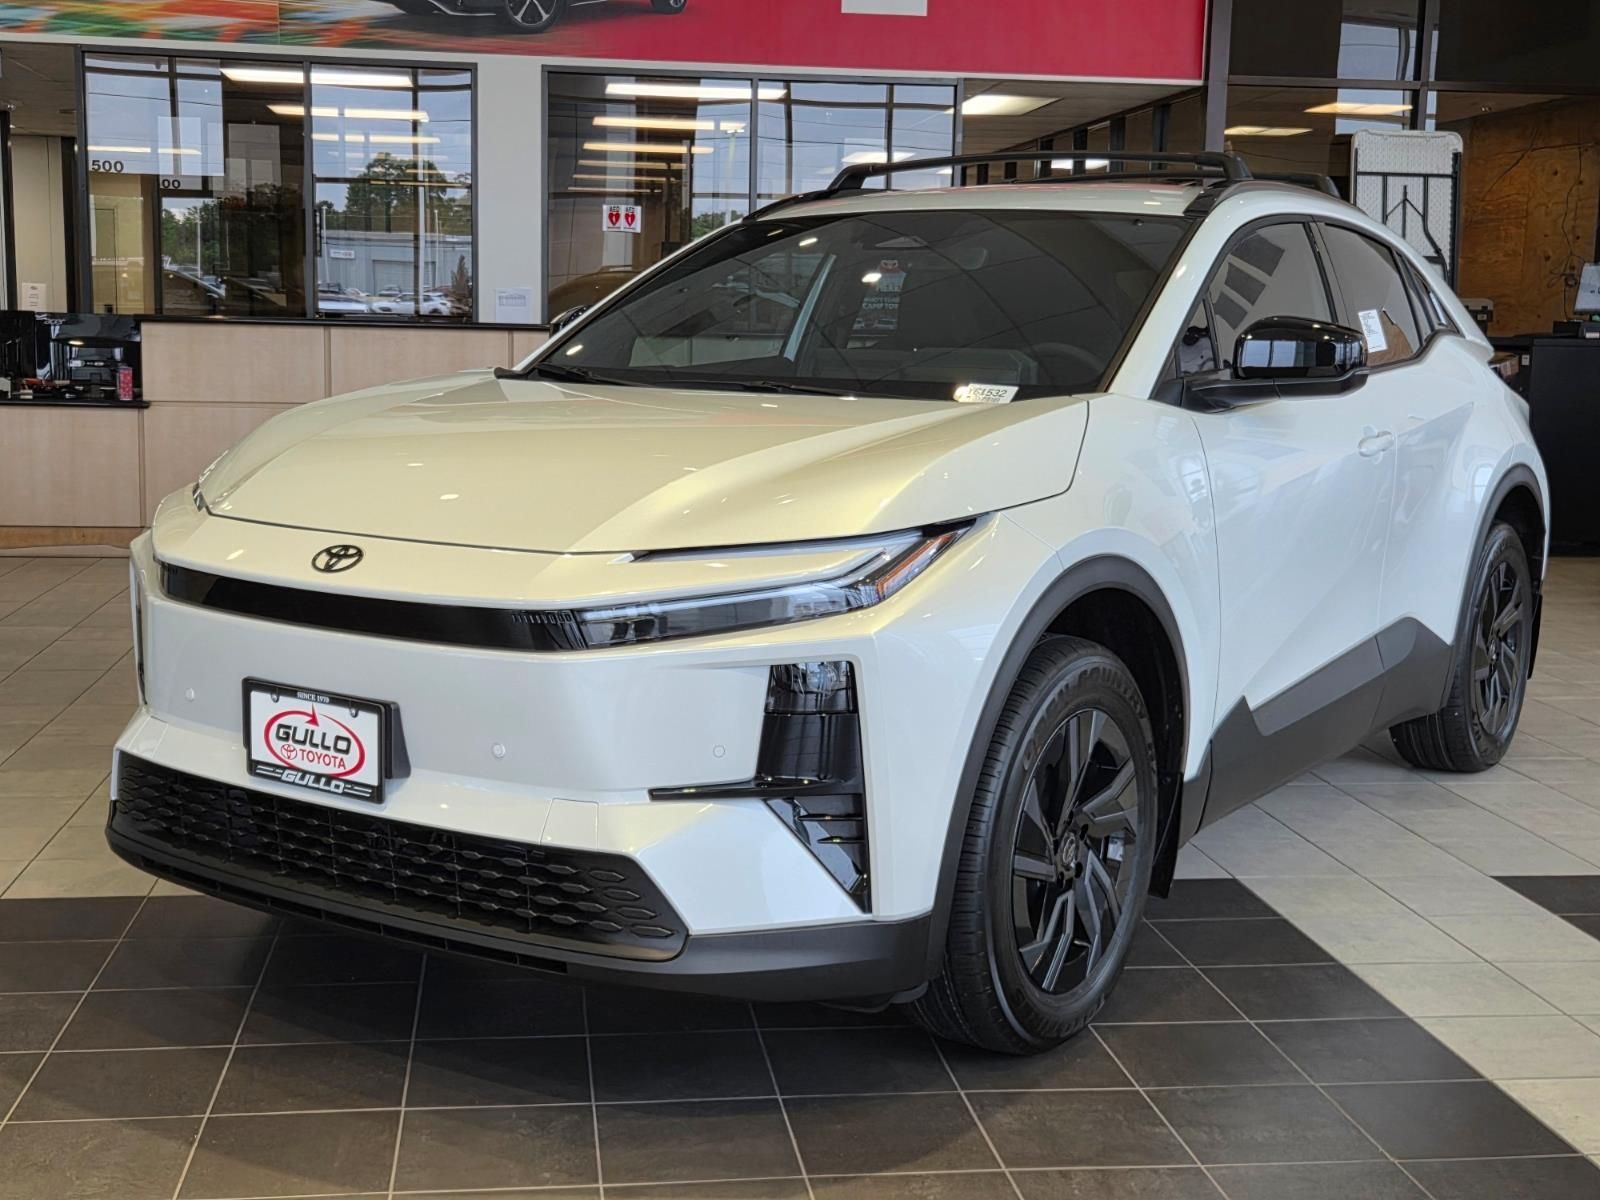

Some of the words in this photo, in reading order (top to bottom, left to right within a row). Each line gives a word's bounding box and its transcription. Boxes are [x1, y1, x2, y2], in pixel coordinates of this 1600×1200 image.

[91, 160, 124, 173] 500
[297, 691, 316, 702] SINCE
[275, 723, 352, 755] GULLO
[299, 748, 346, 770] TOYOTA
[281, 769, 345, 794] GULLO
